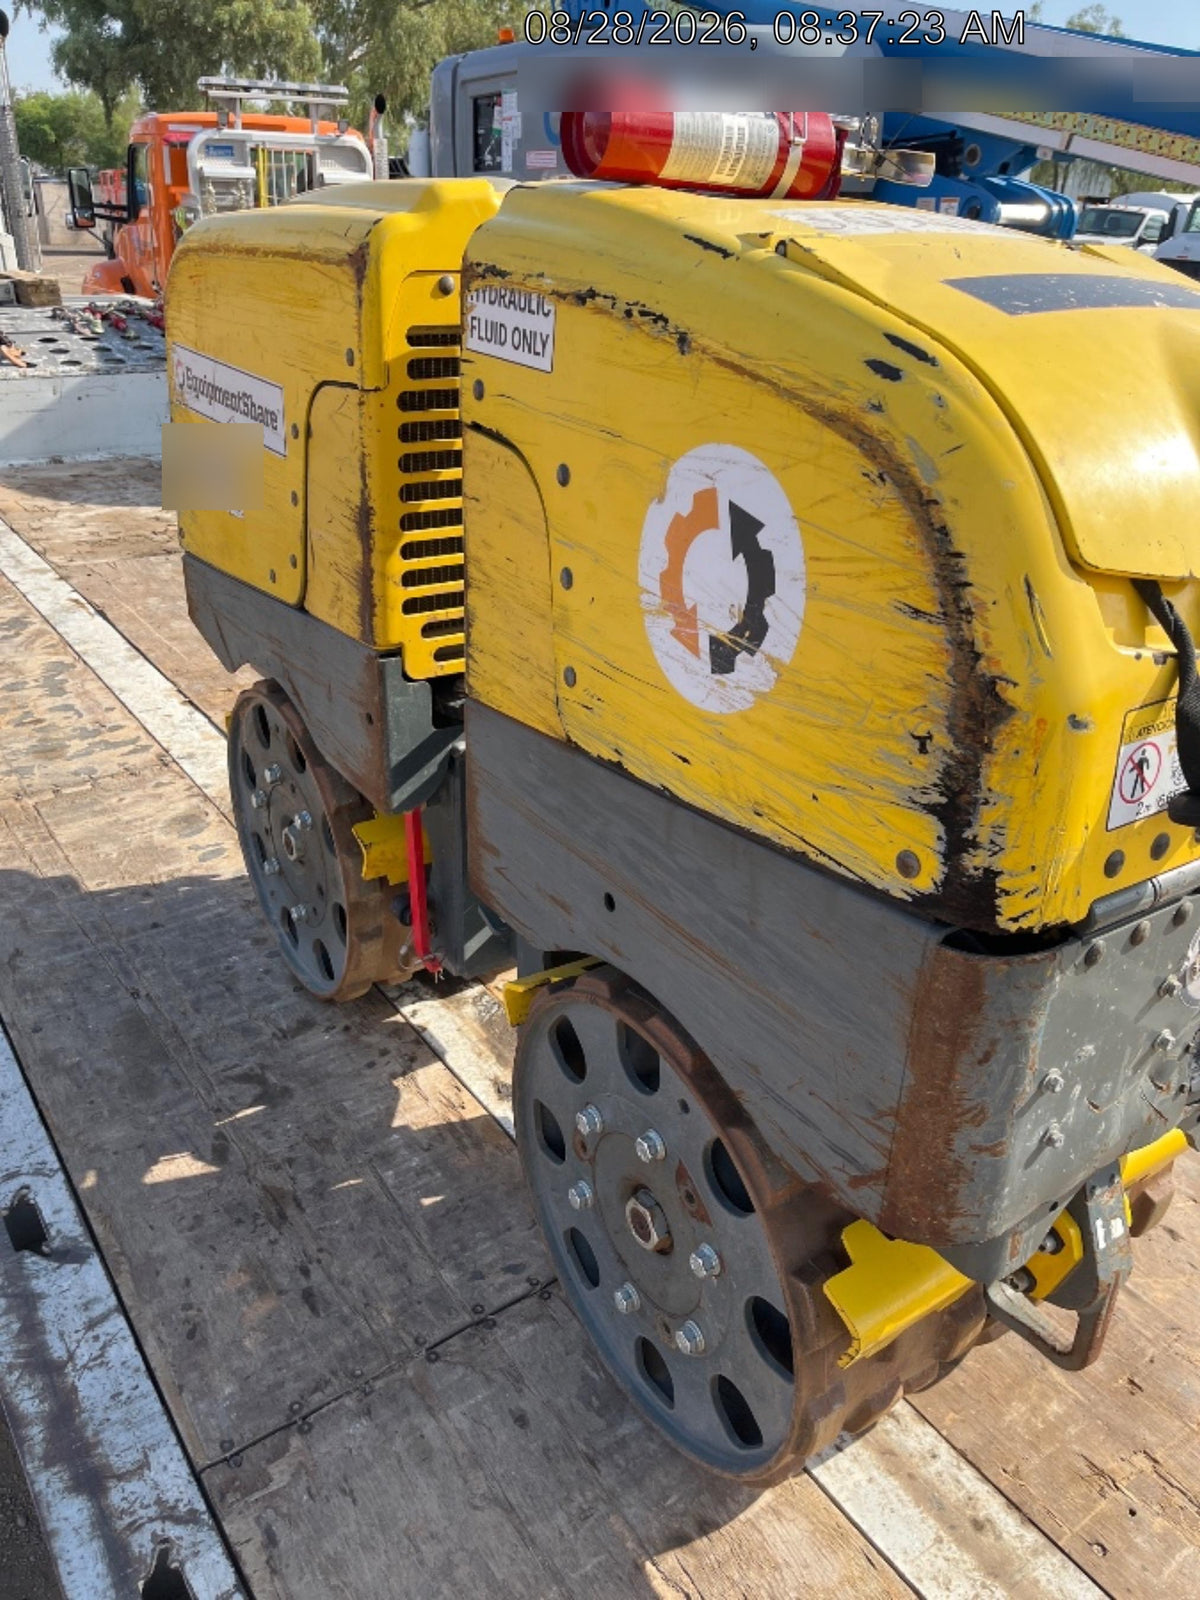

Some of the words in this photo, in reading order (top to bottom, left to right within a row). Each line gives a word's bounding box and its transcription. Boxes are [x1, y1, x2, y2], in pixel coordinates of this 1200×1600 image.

[470, 316, 508, 346] FLUID
[511, 326, 550, 358] ONLY
[185, 366, 278, 431] EquipmentShare
